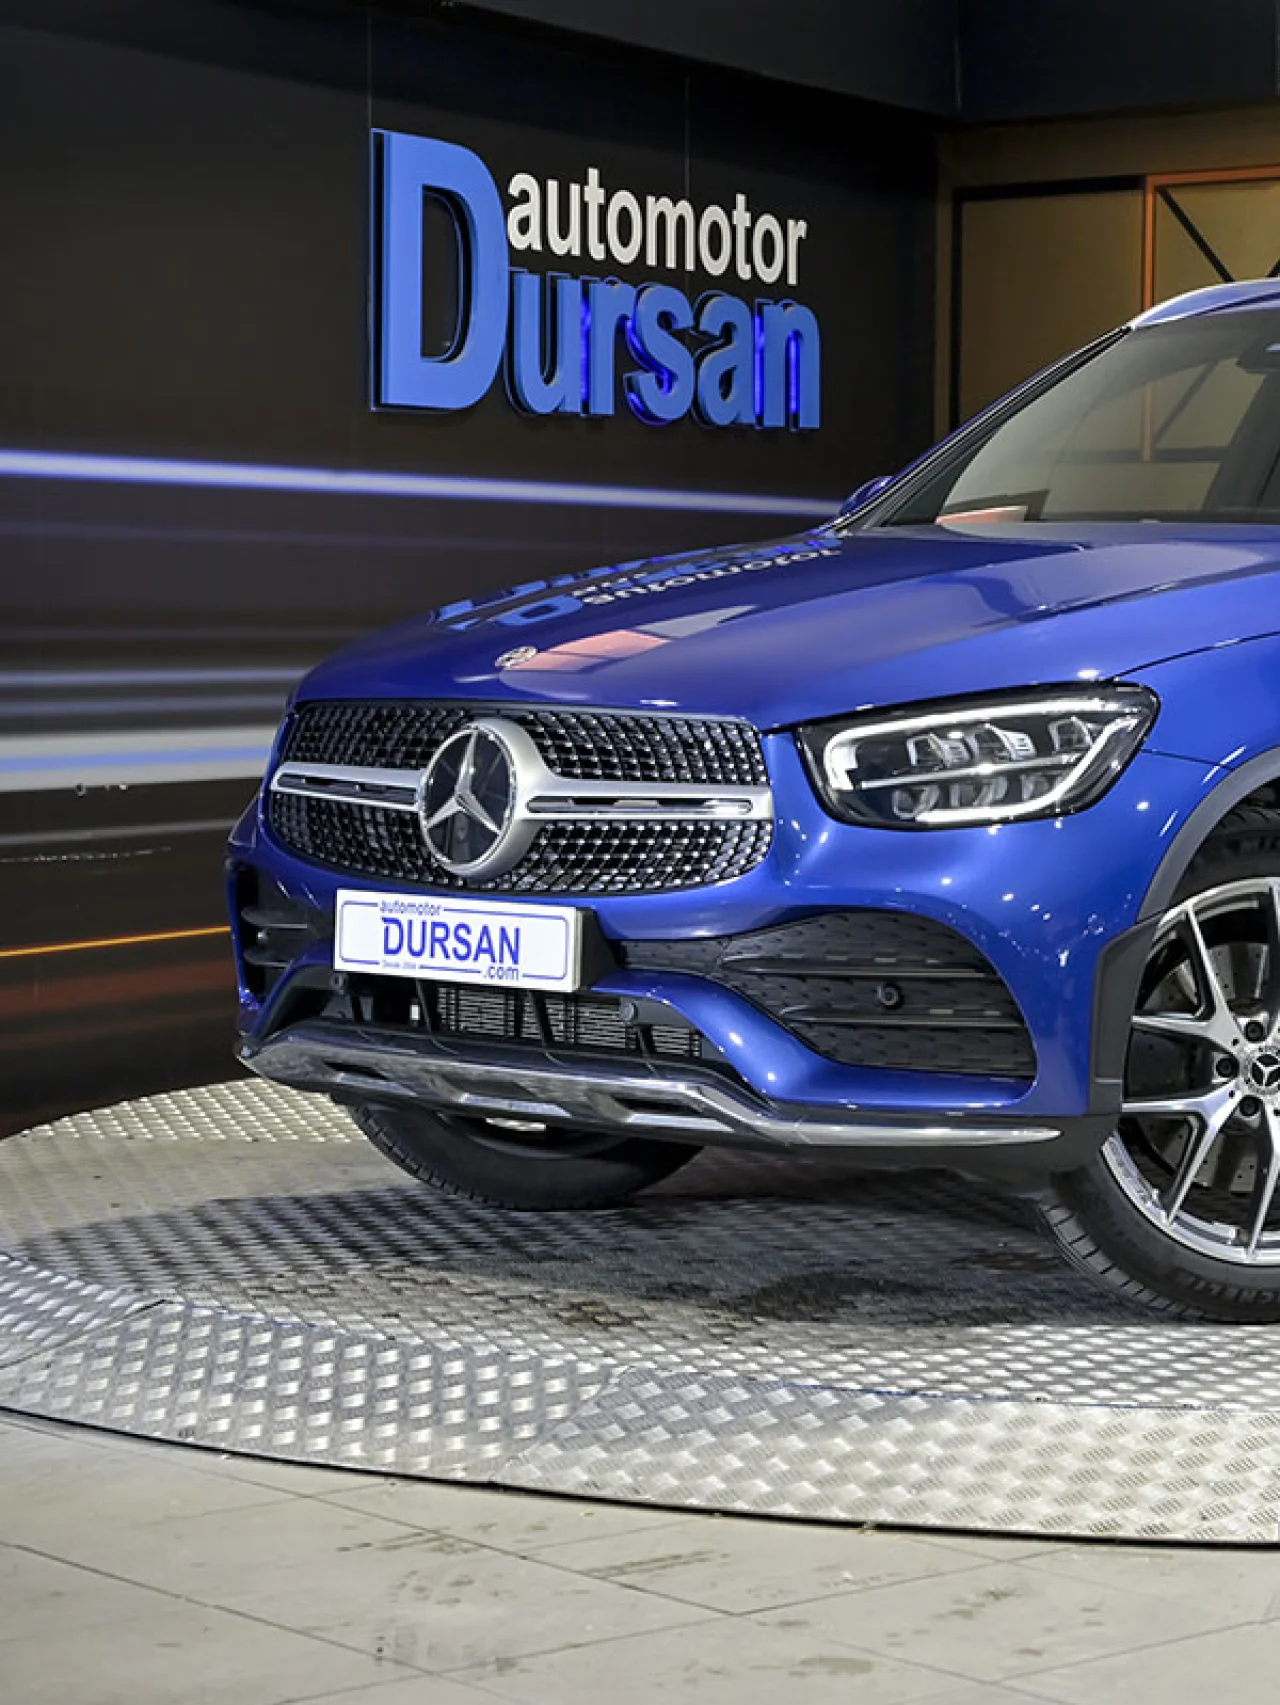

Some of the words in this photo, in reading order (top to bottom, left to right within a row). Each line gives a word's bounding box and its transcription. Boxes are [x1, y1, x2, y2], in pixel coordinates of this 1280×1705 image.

[508, 167, 807, 286] automotor
[371, 128, 820, 431] Dursan
[380, 900, 442, 917] automotor
[381, 917, 520, 965] DURSAN
[483, 965, 519, 981] .com
